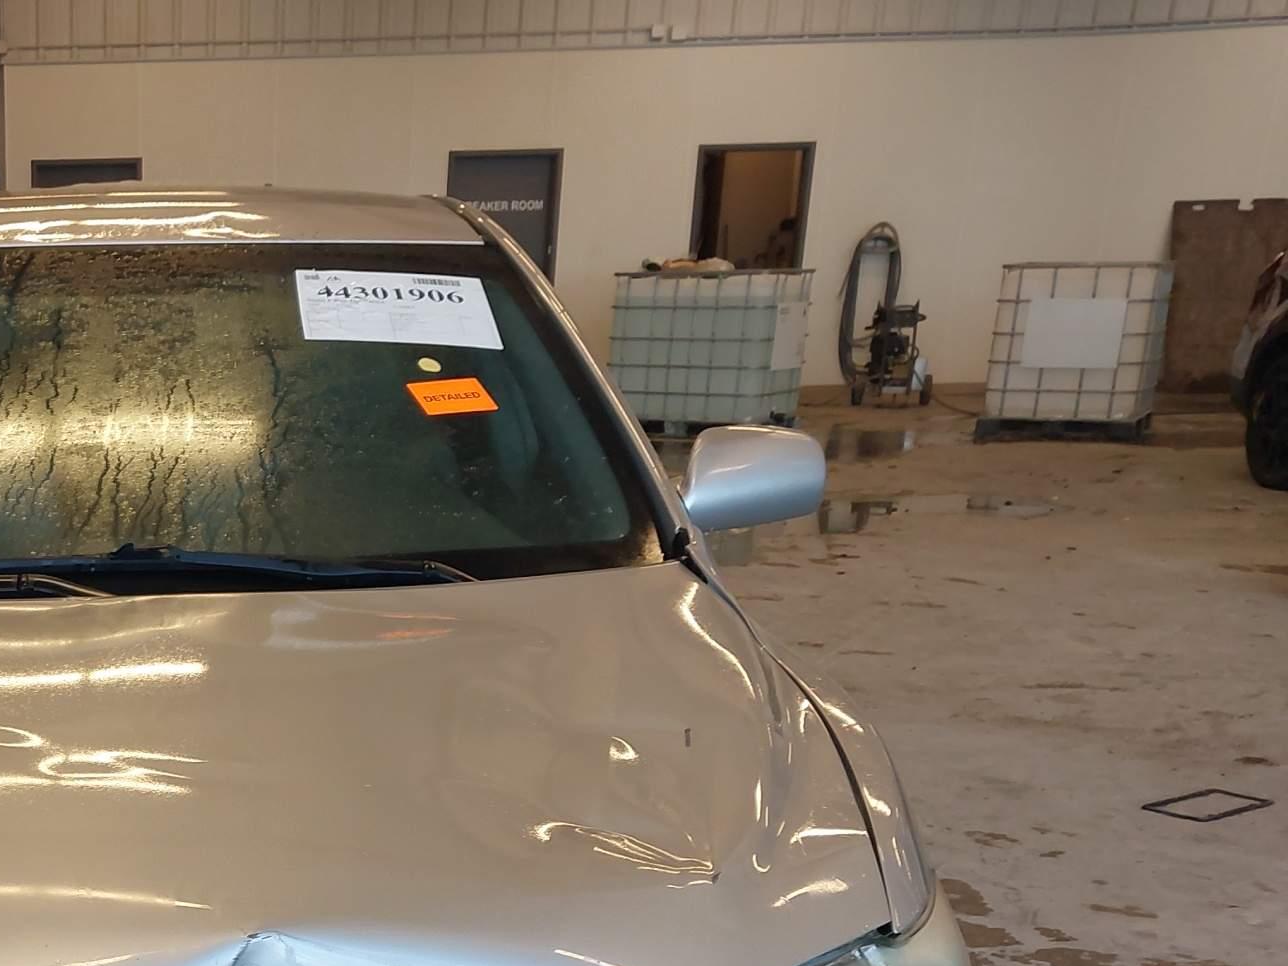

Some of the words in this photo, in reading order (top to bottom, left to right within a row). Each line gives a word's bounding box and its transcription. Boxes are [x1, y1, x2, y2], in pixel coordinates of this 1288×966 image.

[511, 199, 544, 212] ROOM
[317, 285, 464, 304] 44301906
[423, 391, 481, 403] DETAILED
